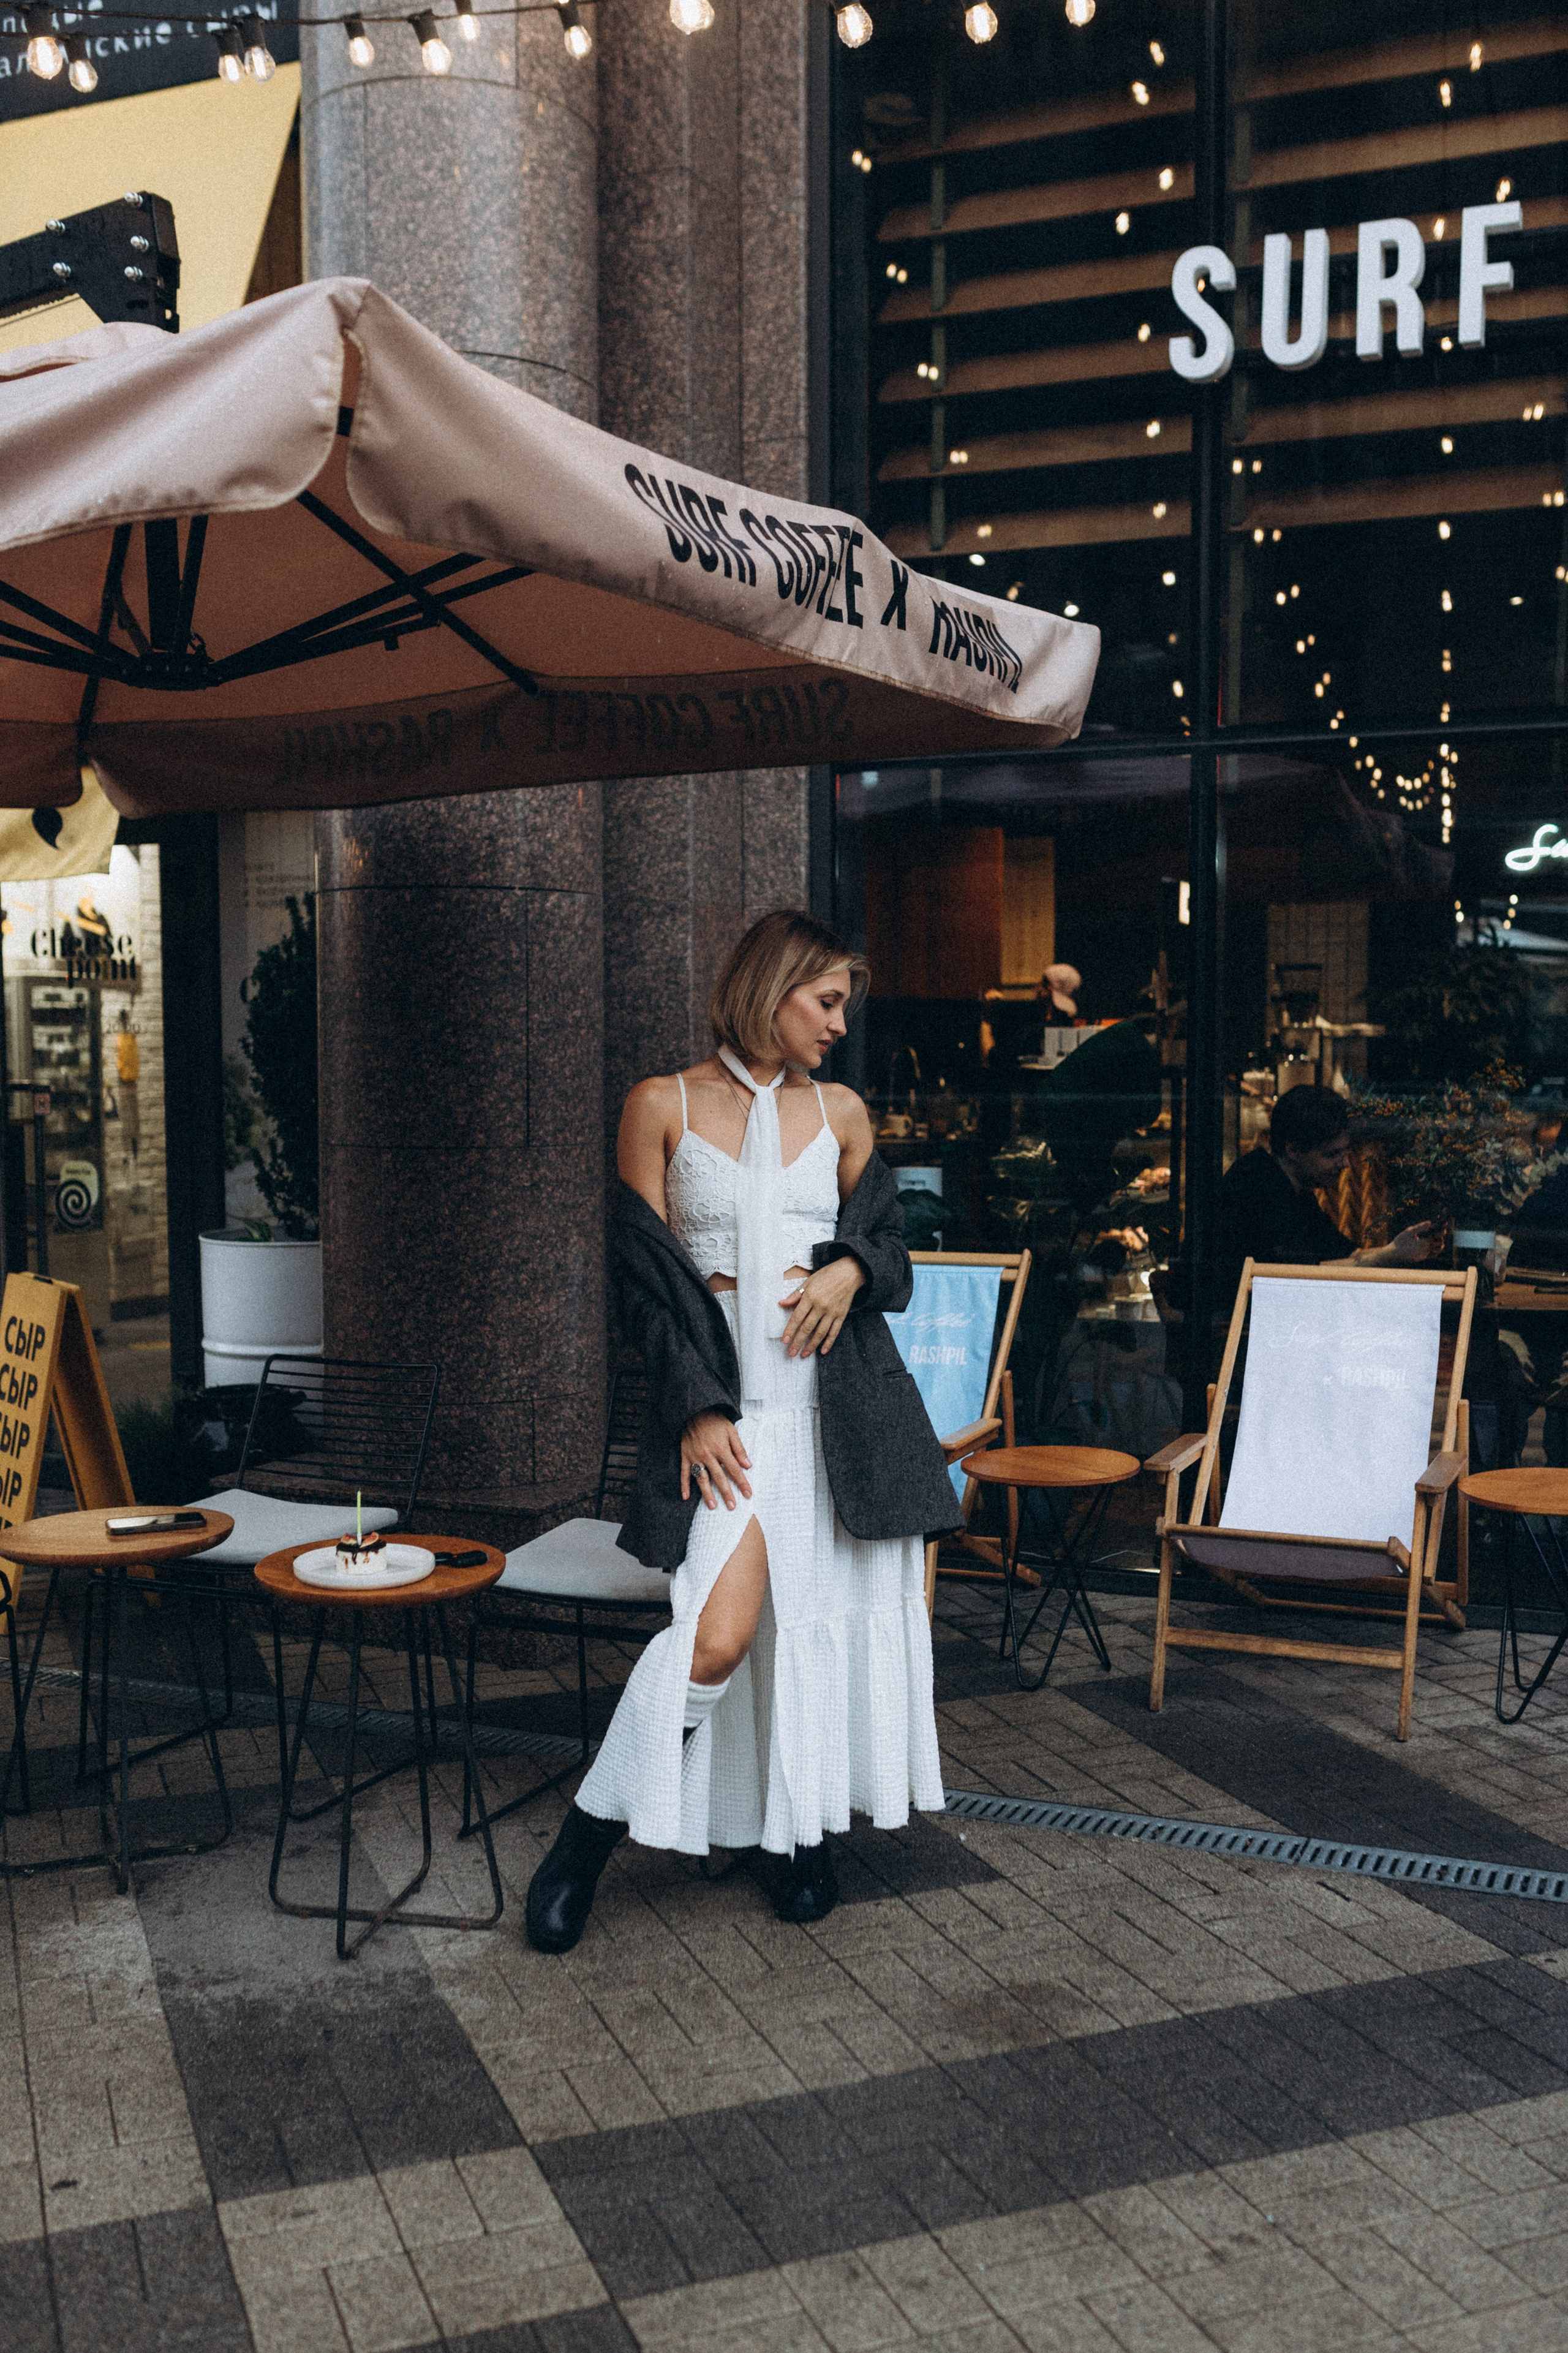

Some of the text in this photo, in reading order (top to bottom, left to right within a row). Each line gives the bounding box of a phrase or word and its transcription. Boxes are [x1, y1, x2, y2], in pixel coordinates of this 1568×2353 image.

[1169, 200, 1522, 383] SURF
[624, 463, 756, 587] SURF
[739, 507, 864, 630] COFFEE
[5, 1316, 45, 1361] СЫР
[908, 1344, 968, 1365] RASHPIL
[0, 1363, 37, 1411] СЫР
[0, 1411, 30, 1459] ЫР
